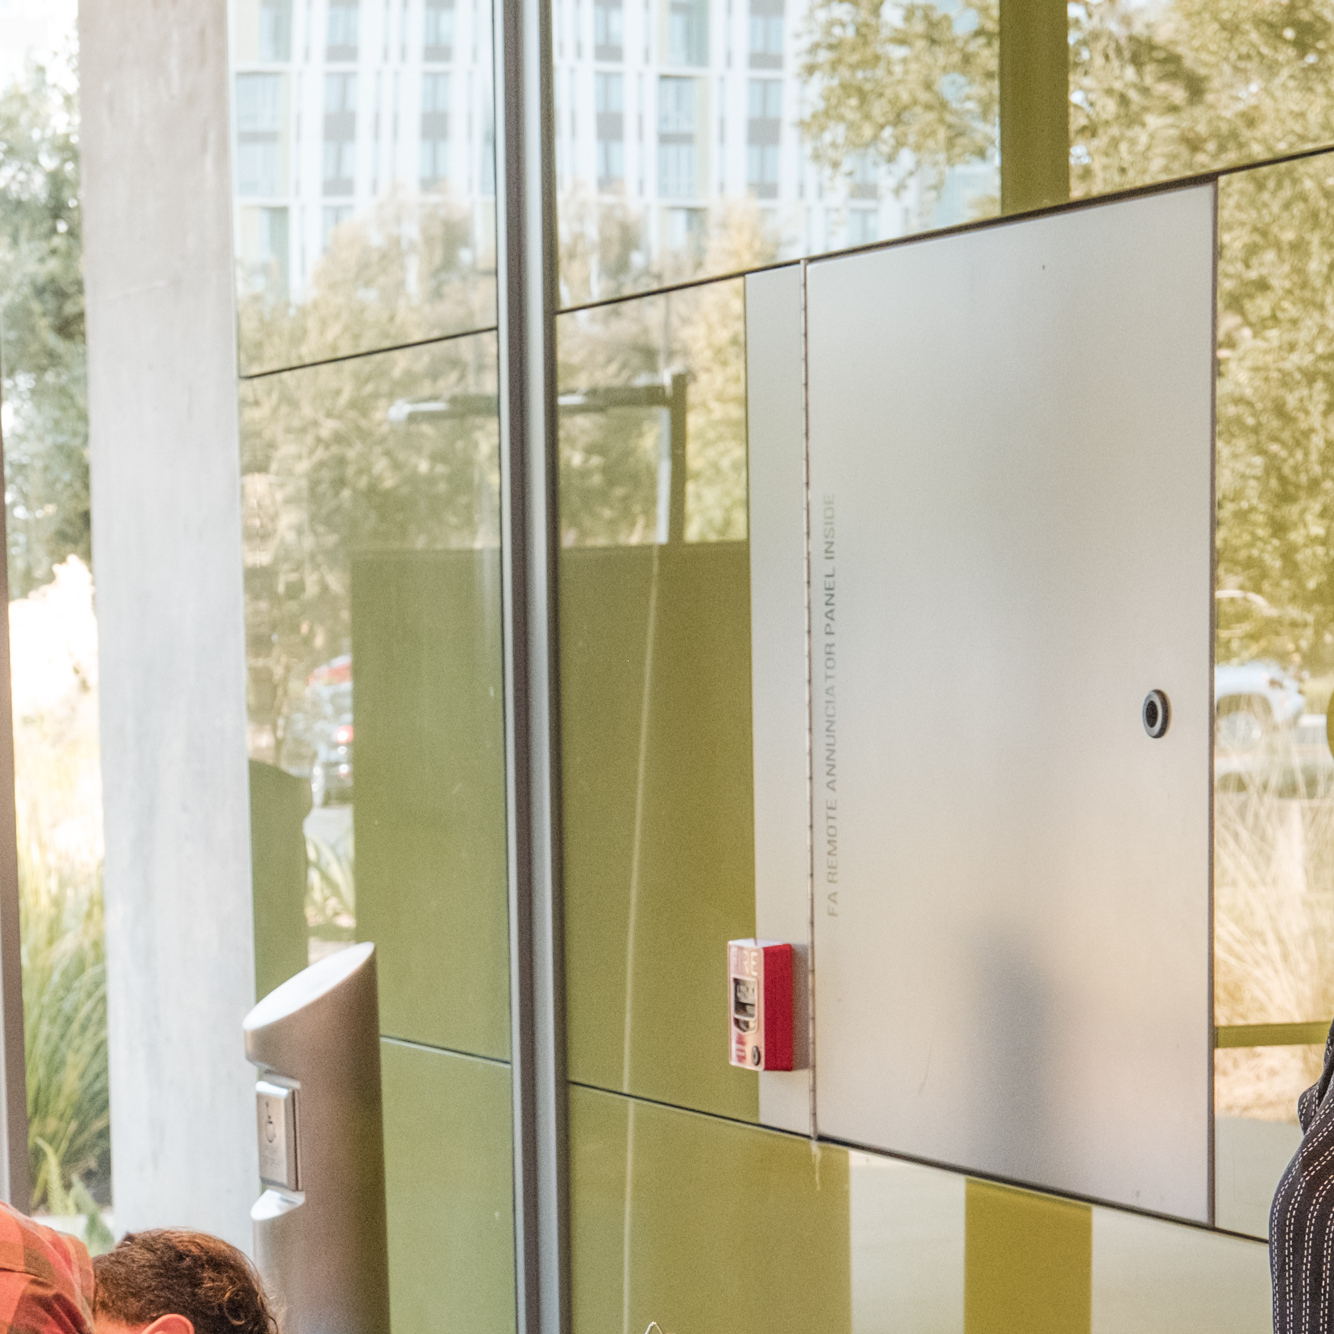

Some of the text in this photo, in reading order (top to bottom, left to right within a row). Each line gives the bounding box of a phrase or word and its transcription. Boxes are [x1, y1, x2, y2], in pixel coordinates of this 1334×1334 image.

[823, 492, 838, 919] FA REMOTE ANNUNCIATOR PANEL INSIDE
